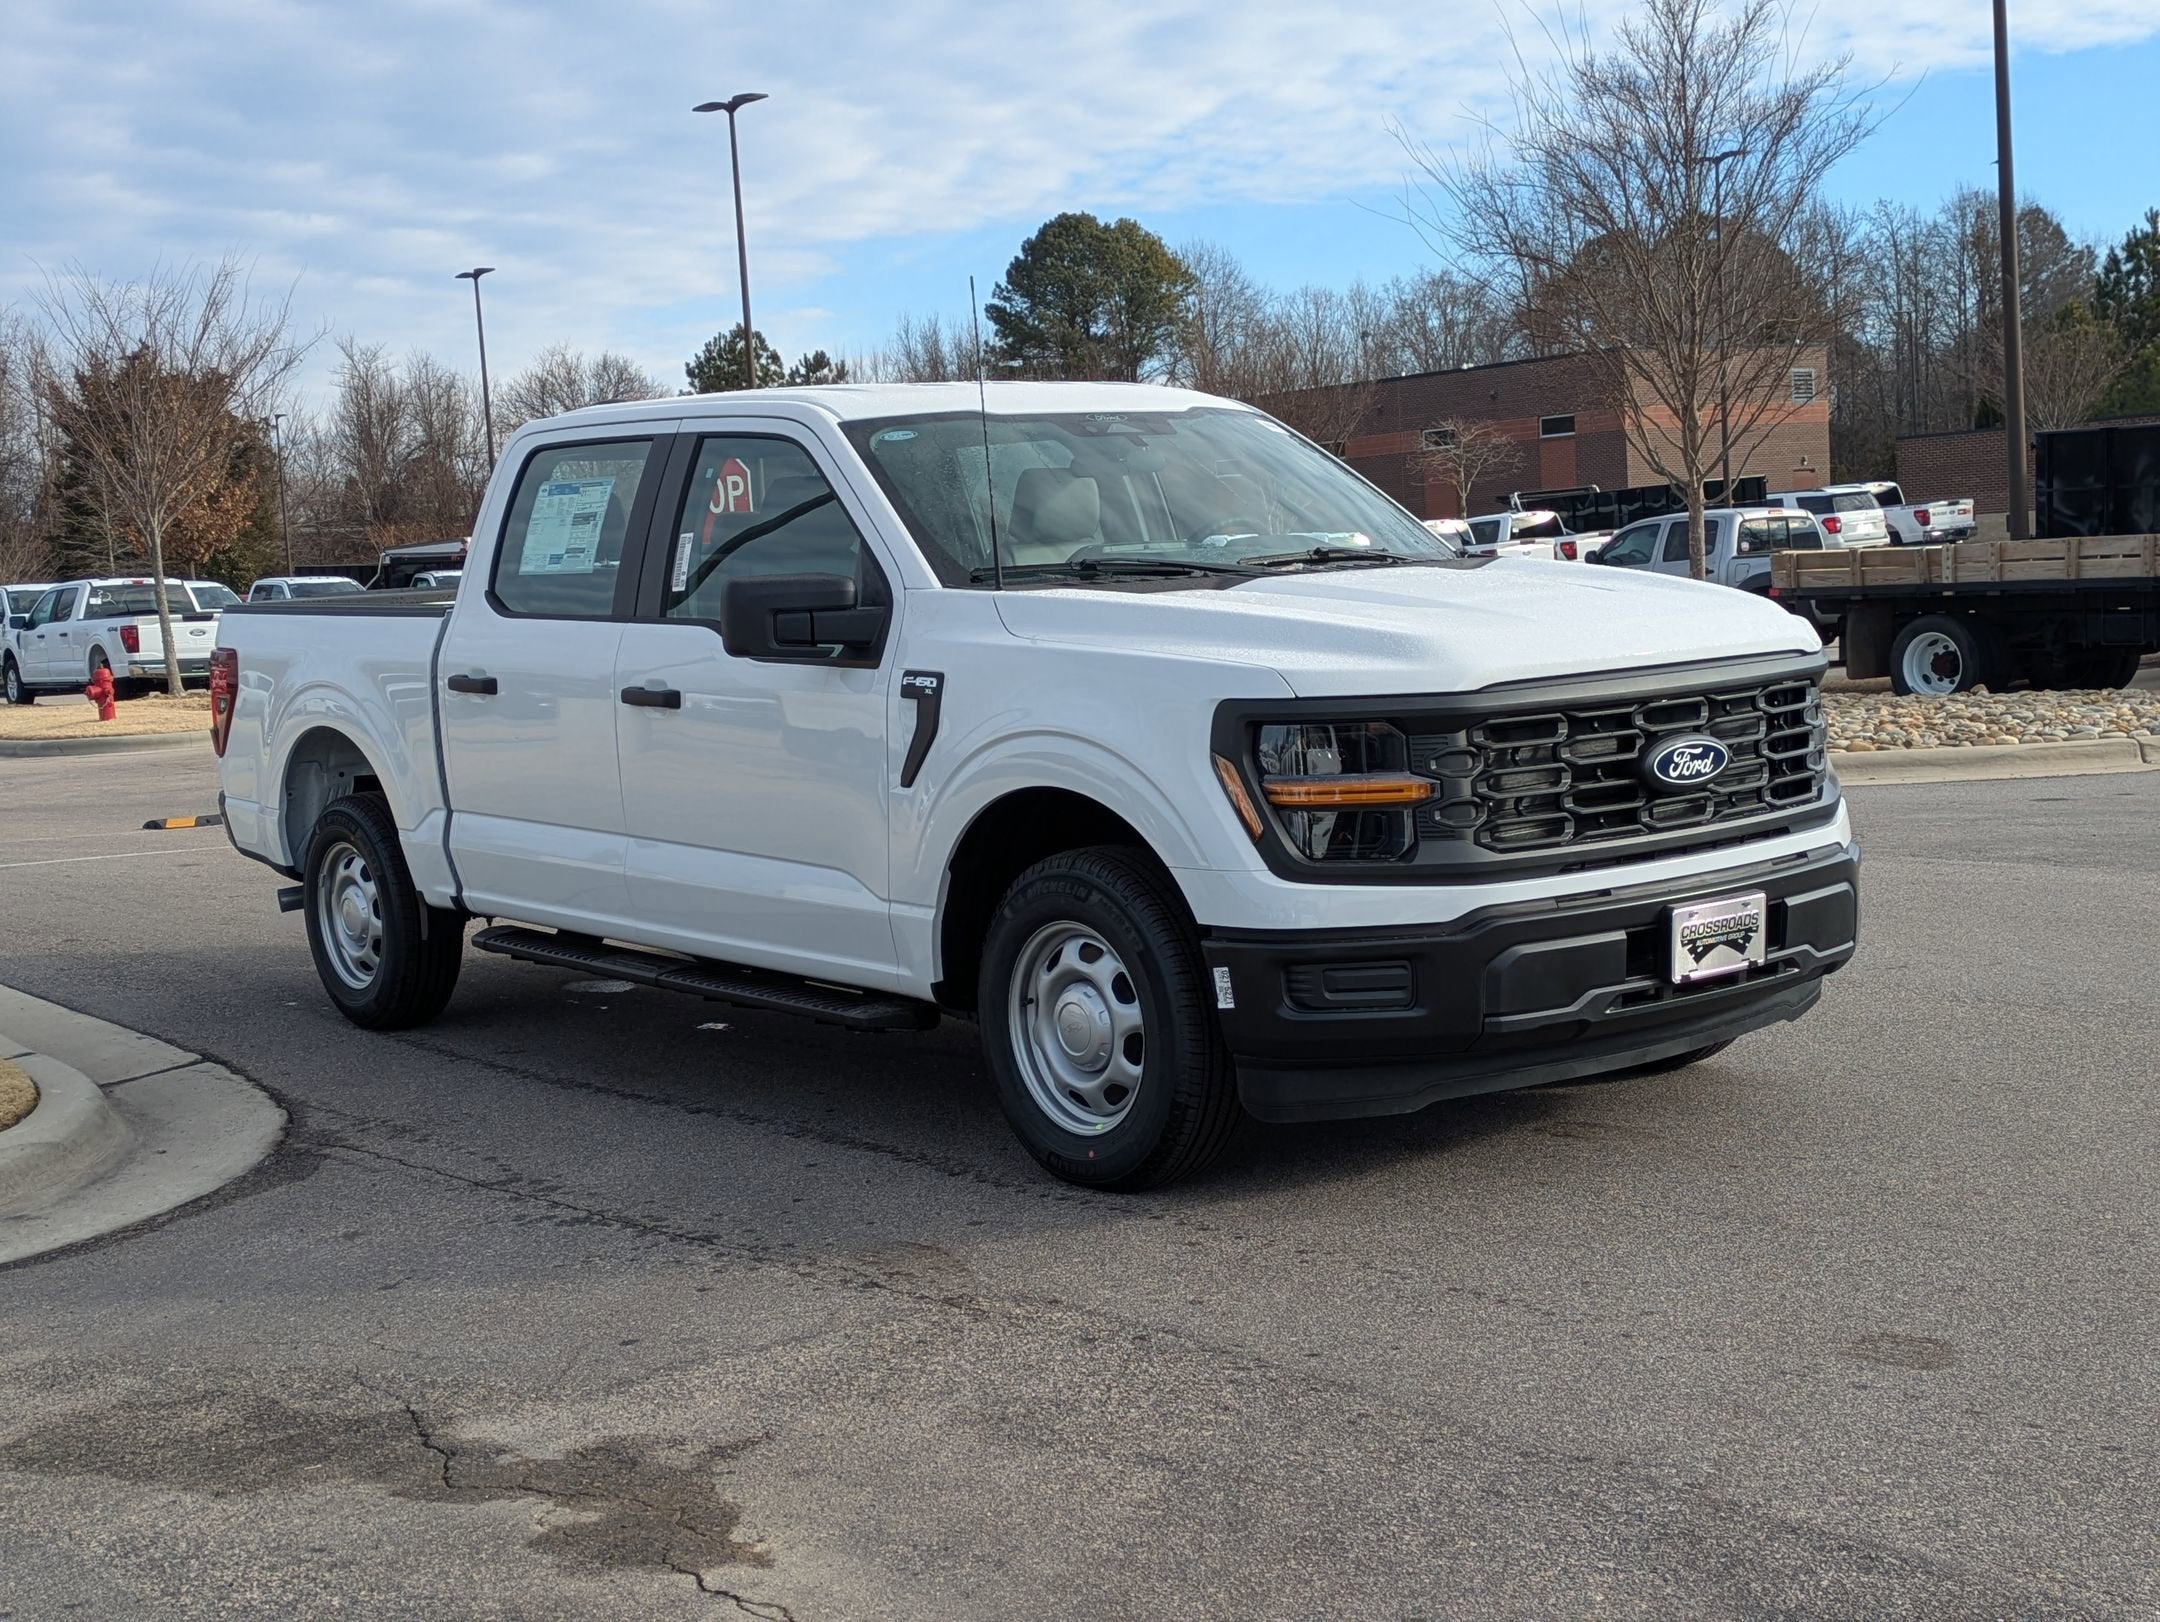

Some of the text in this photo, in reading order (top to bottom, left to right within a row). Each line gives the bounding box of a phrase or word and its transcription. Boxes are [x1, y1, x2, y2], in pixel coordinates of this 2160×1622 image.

[709, 475, 745, 514] OP
[1669, 747, 1714, 777] Ford
[1681, 912, 1759, 940] CROSSROADS
